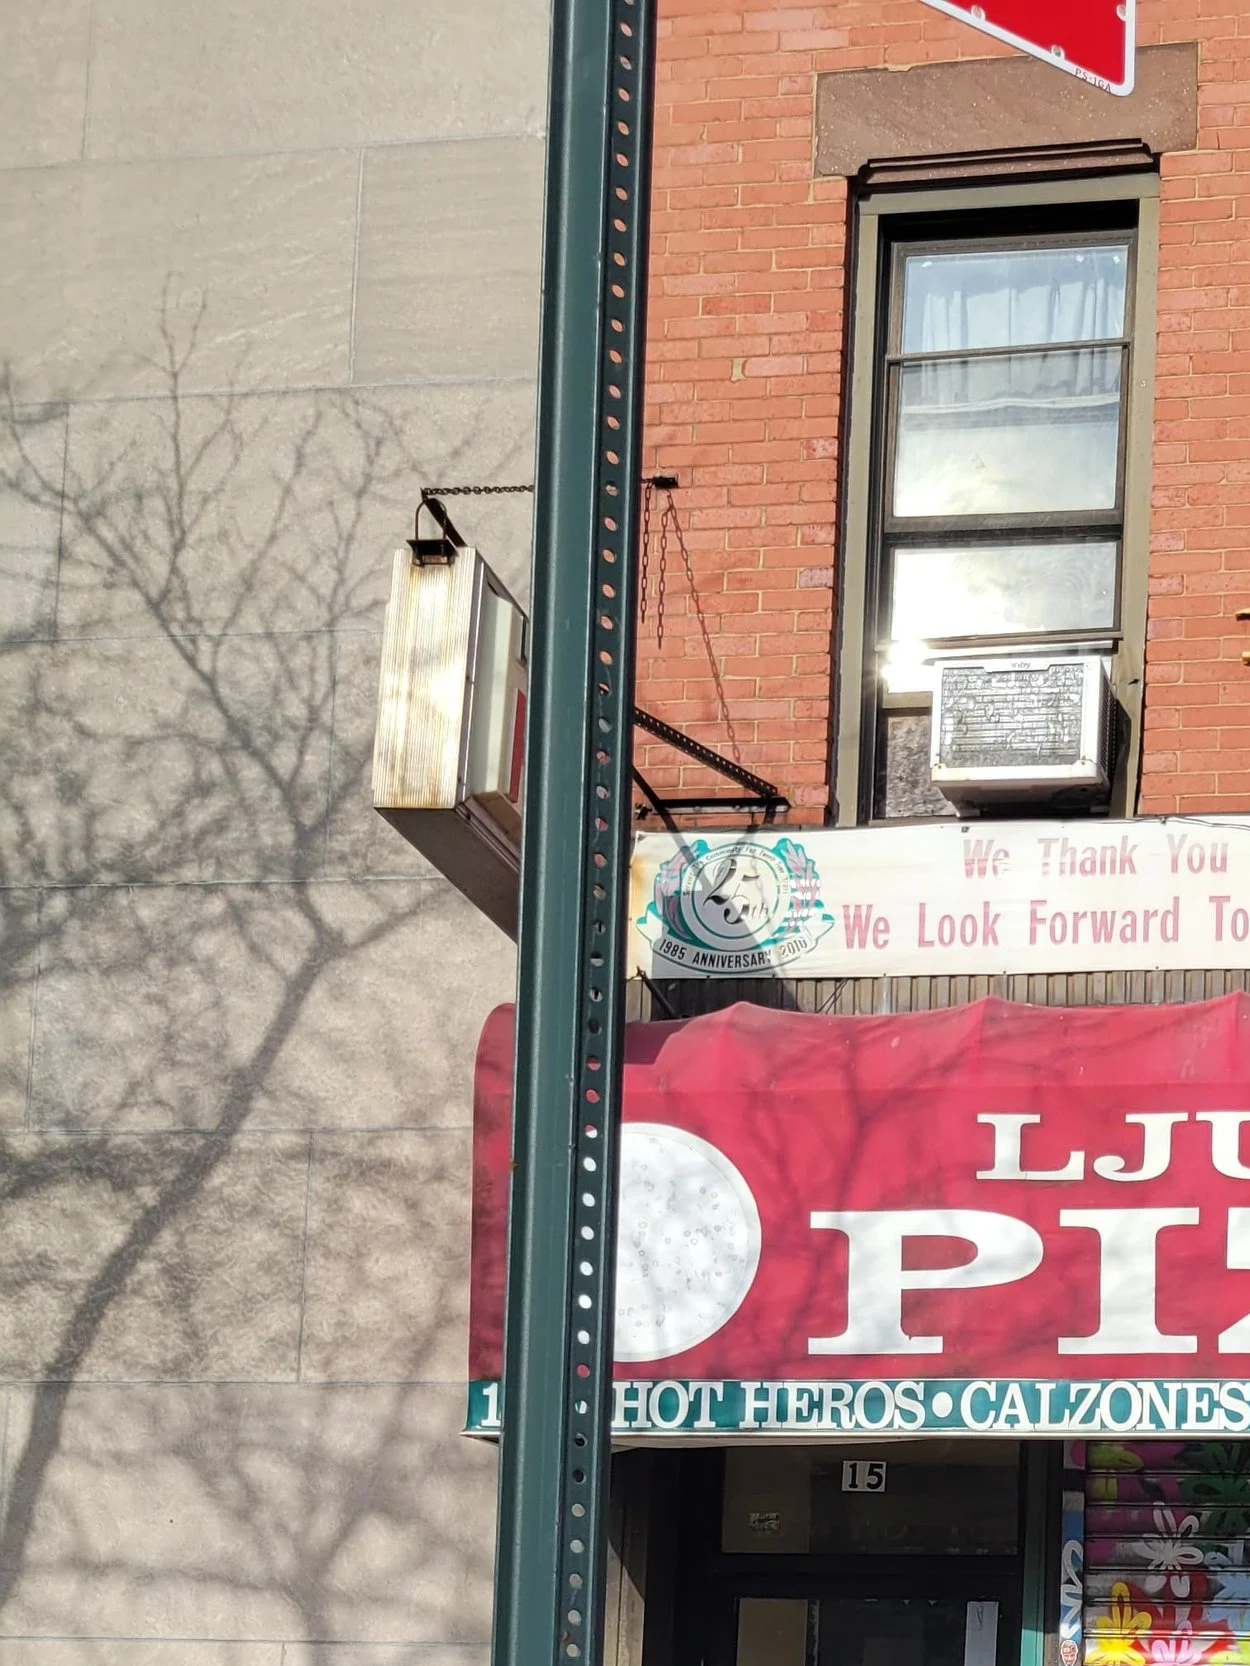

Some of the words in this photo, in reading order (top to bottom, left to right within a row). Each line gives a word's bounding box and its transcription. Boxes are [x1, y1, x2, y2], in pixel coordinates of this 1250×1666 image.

[962, 837, 1010, 879] We
[1038, 836, 1137, 877] Thank
[1167, 832, 1228, 875] You
[842, 904, 890, 950] We
[918, 900, 1001, 949] Look
[1029, 895, 1180, 946] Forward
[1209, 893, 1250, 943] To
[659, 939, 688, 960] 1985
[692, 948, 772, 969] ANNIVERSARY
[612, 1380, 724, 1429] HOT
[742, 1380, 926, 1431] HEROS
[848, 1462, 884, 1490] 15
